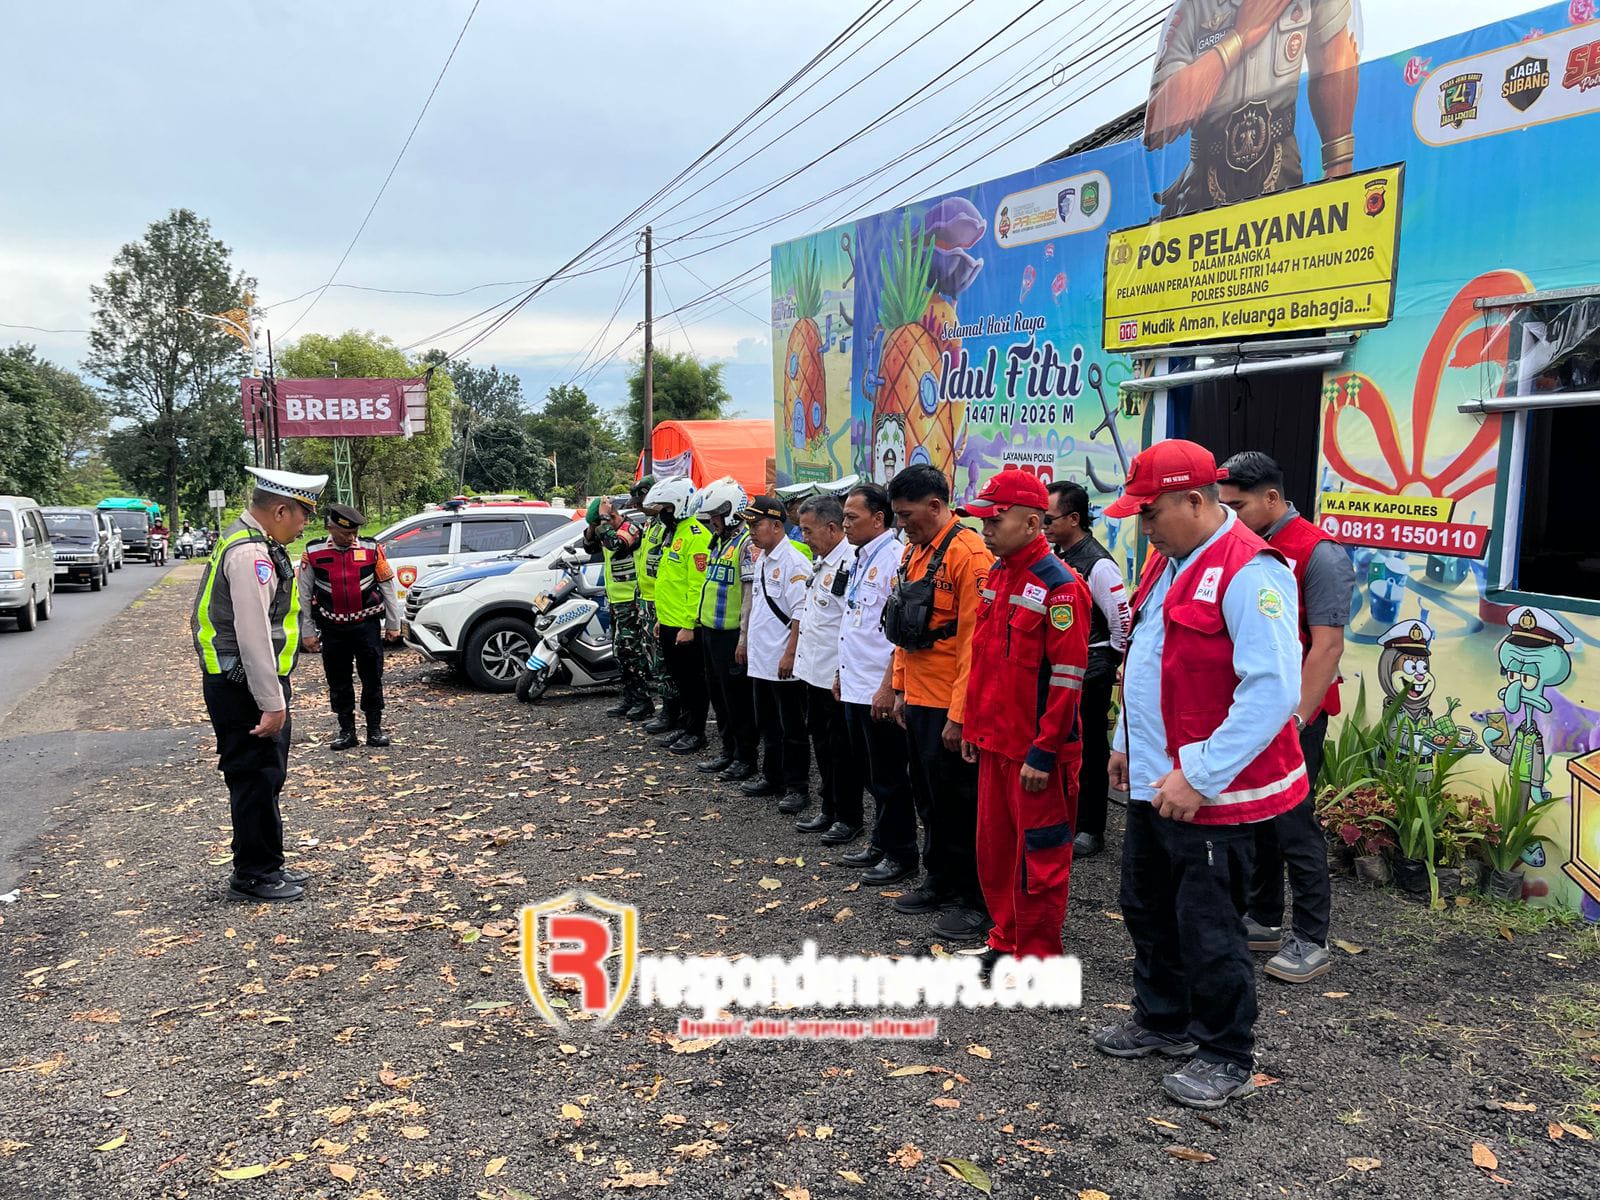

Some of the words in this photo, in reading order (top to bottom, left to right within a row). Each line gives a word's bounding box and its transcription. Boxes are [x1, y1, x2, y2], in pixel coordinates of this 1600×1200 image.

[1510, 61, 1541, 80] JAGA
[1502, 73, 1550, 97] SUBANG
[1137, 238, 1181, 269] POS
[1188, 202, 1349, 260] PELAYANAN
[1193, 255, 1226, 272] DALAM
[1227, 248, 1271, 267] RANGKA
[1117, 282, 1165, 299] PELAYANAN
[1167, 273, 1215, 292] PERAYAAN
[1217, 269, 1238, 284] IDUL
[1240, 265, 1264, 281] FITRI
[1266, 260, 1290, 275] 1447
[1292, 258, 1300, 271] H
[1303, 252, 1342, 270] TAHUN
[1345, 246, 1374, 263] 2026
[1191, 285, 1225, 302] POLRES
[1227, 280, 1269, 299] SUBANG
[942, 317, 983, 340] Selamat
[987, 313, 1011, 335] Hari
[1014, 312, 1045, 335] Raya
[1120, 323, 1138, 340] 110
[1142, 318, 1175, 336] Mudik
[1179, 316, 1219, 331] Aman,
[1222, 309, 1286, 328] Keluarga
[939, 348, 996, 400] Idul
[1006, 337, 1083, 398] Fitri
[285, 398, 392, 421] BREBES
[966, 405, 995, 423] 1447
[1021, 404, 1056, 424] 2026
[1063, 404, 1074, 423] M
[1003, 452, 1033, 462] LAYANAN
[1033, 453, 1055, 463] POLISI
[1327, 499, 1346, 510] W.A
[1349, 501, 1370, 512] PAK
[1374, 503, 1438, 516] KAPOLRES
[1342, 521, 1385, 541] 0813
[1391, 525, 1477, 549] 1550110
[1197, 588, 1214, 598] PMI
[558, 604, 590, 621] POLISI
